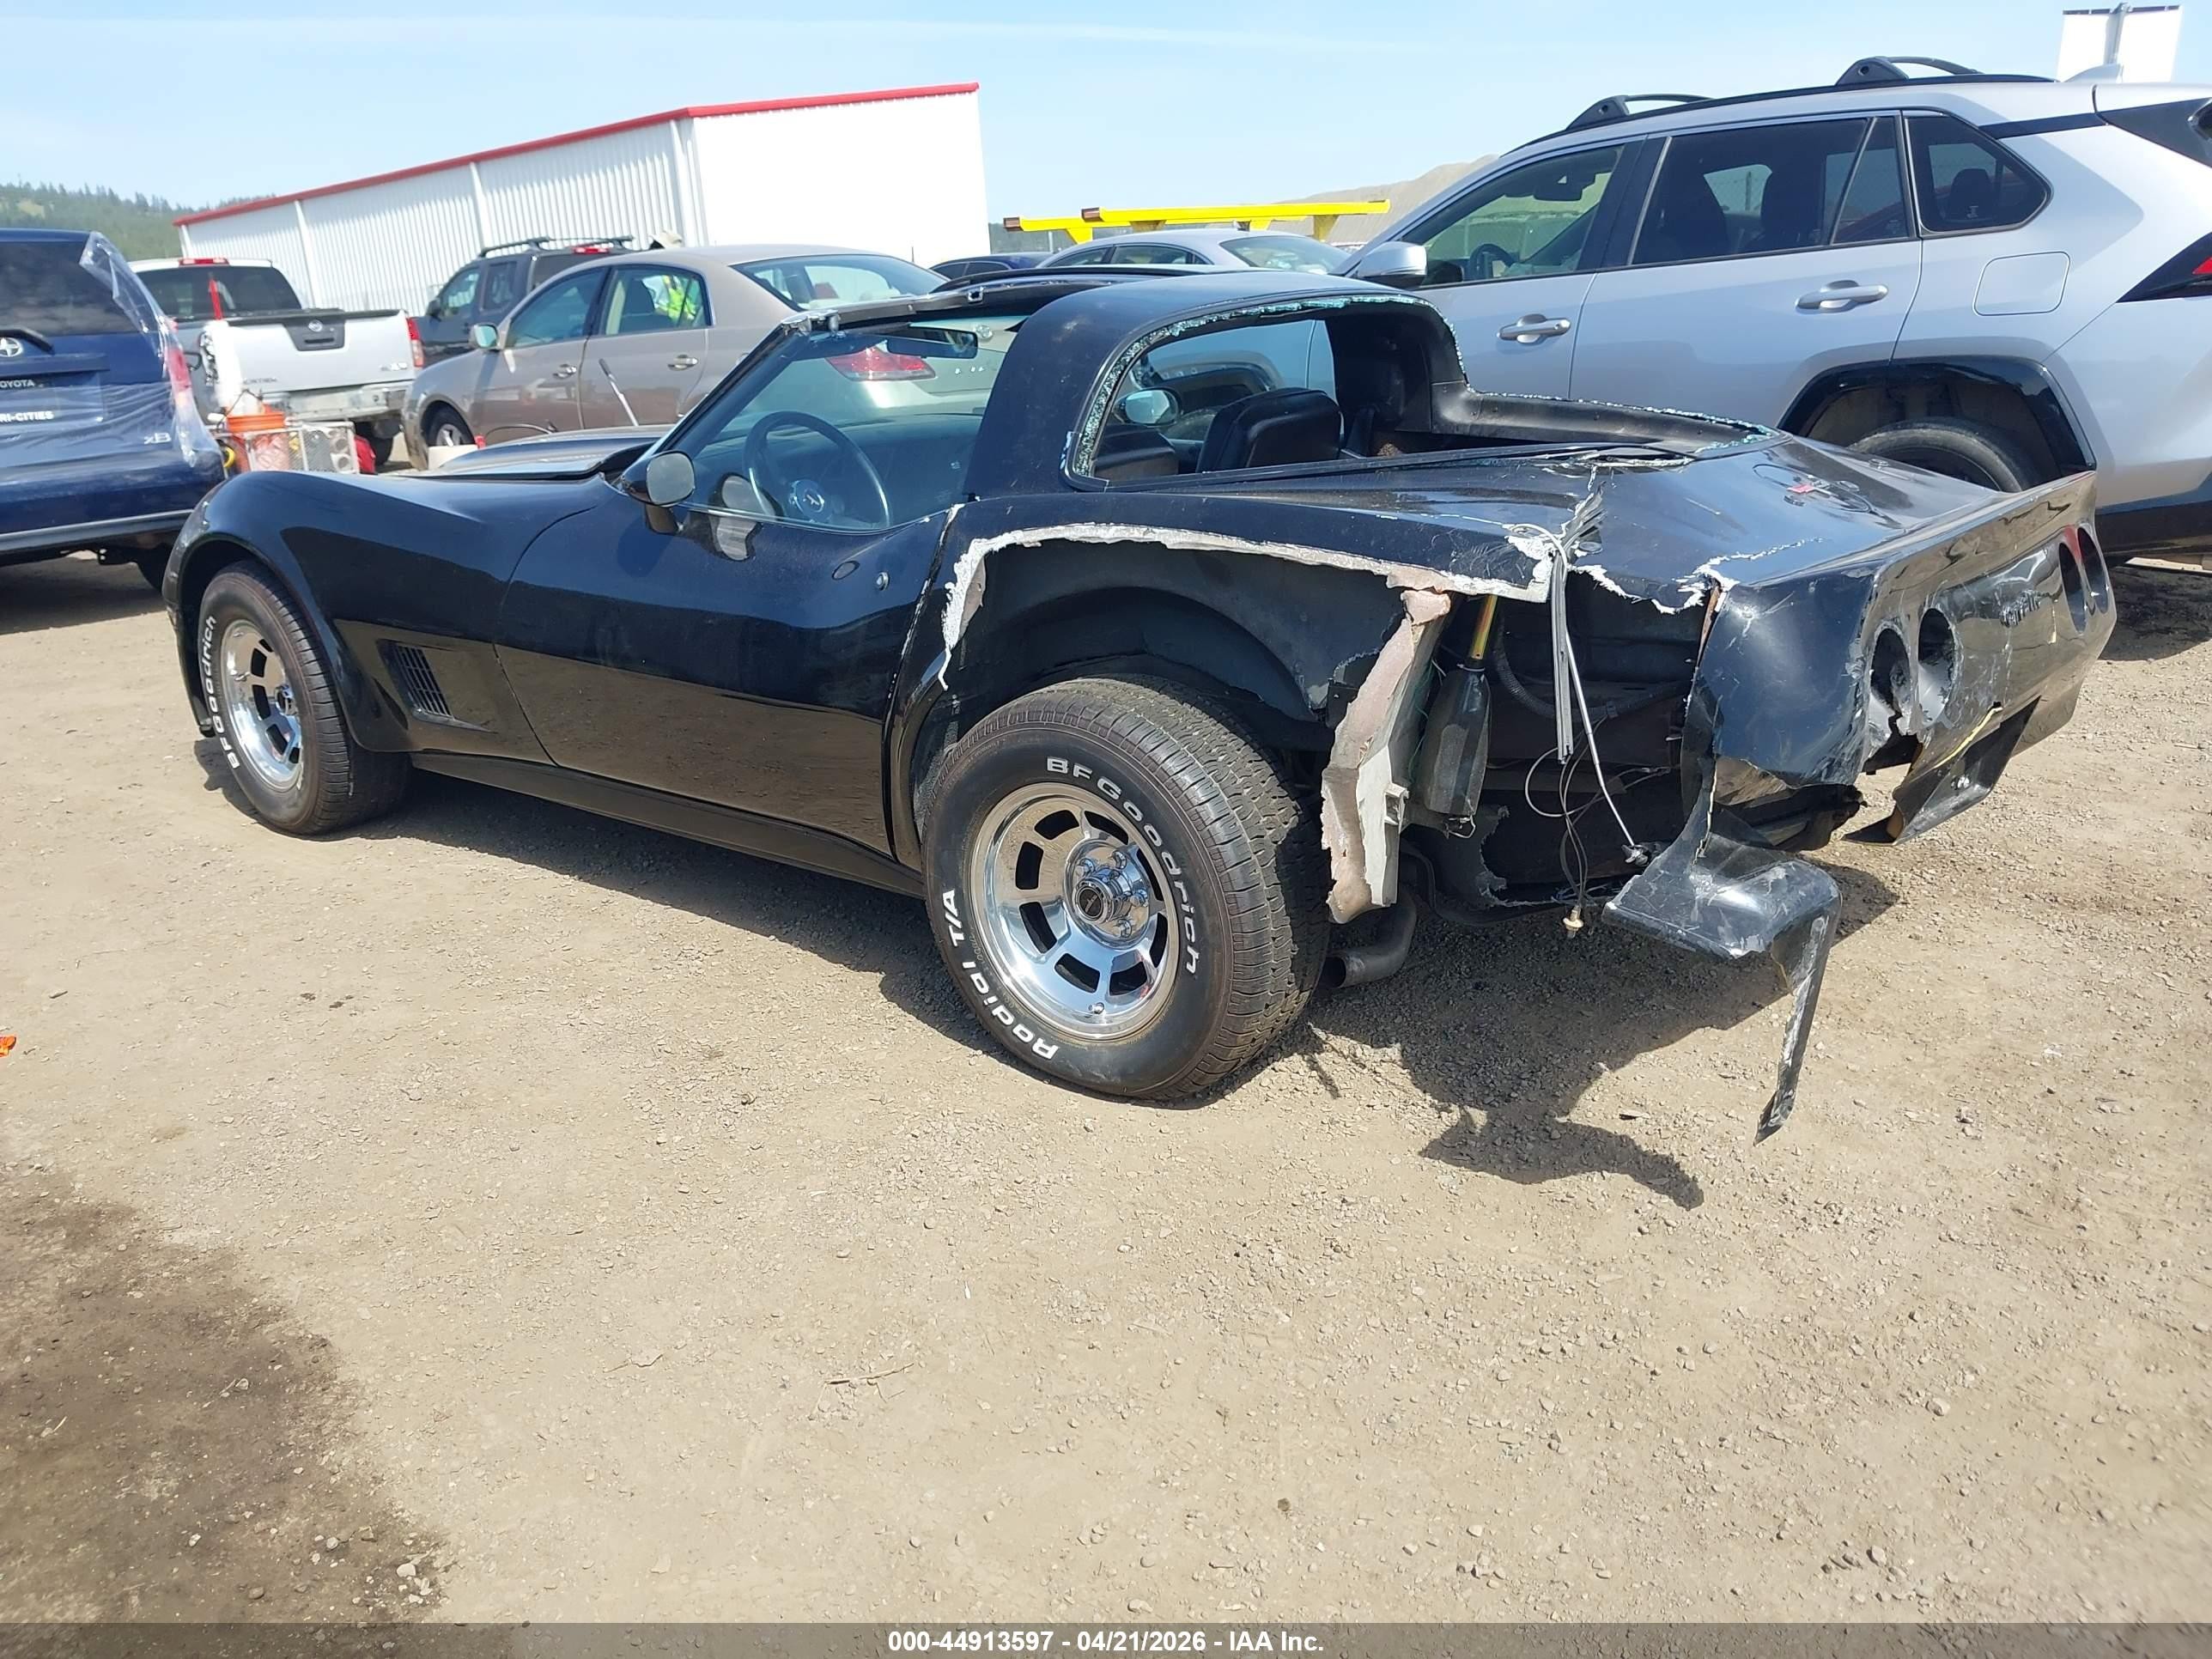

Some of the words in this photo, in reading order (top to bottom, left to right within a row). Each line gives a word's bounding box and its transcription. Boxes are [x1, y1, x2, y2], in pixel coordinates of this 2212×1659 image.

[198, 615, 240, 769] BFGoodrich
[942, 889, 965, 947] T/A
[1046, 757, 1200, 975] BFGoodrich
[963, 961, 1060, 1061] Radial
